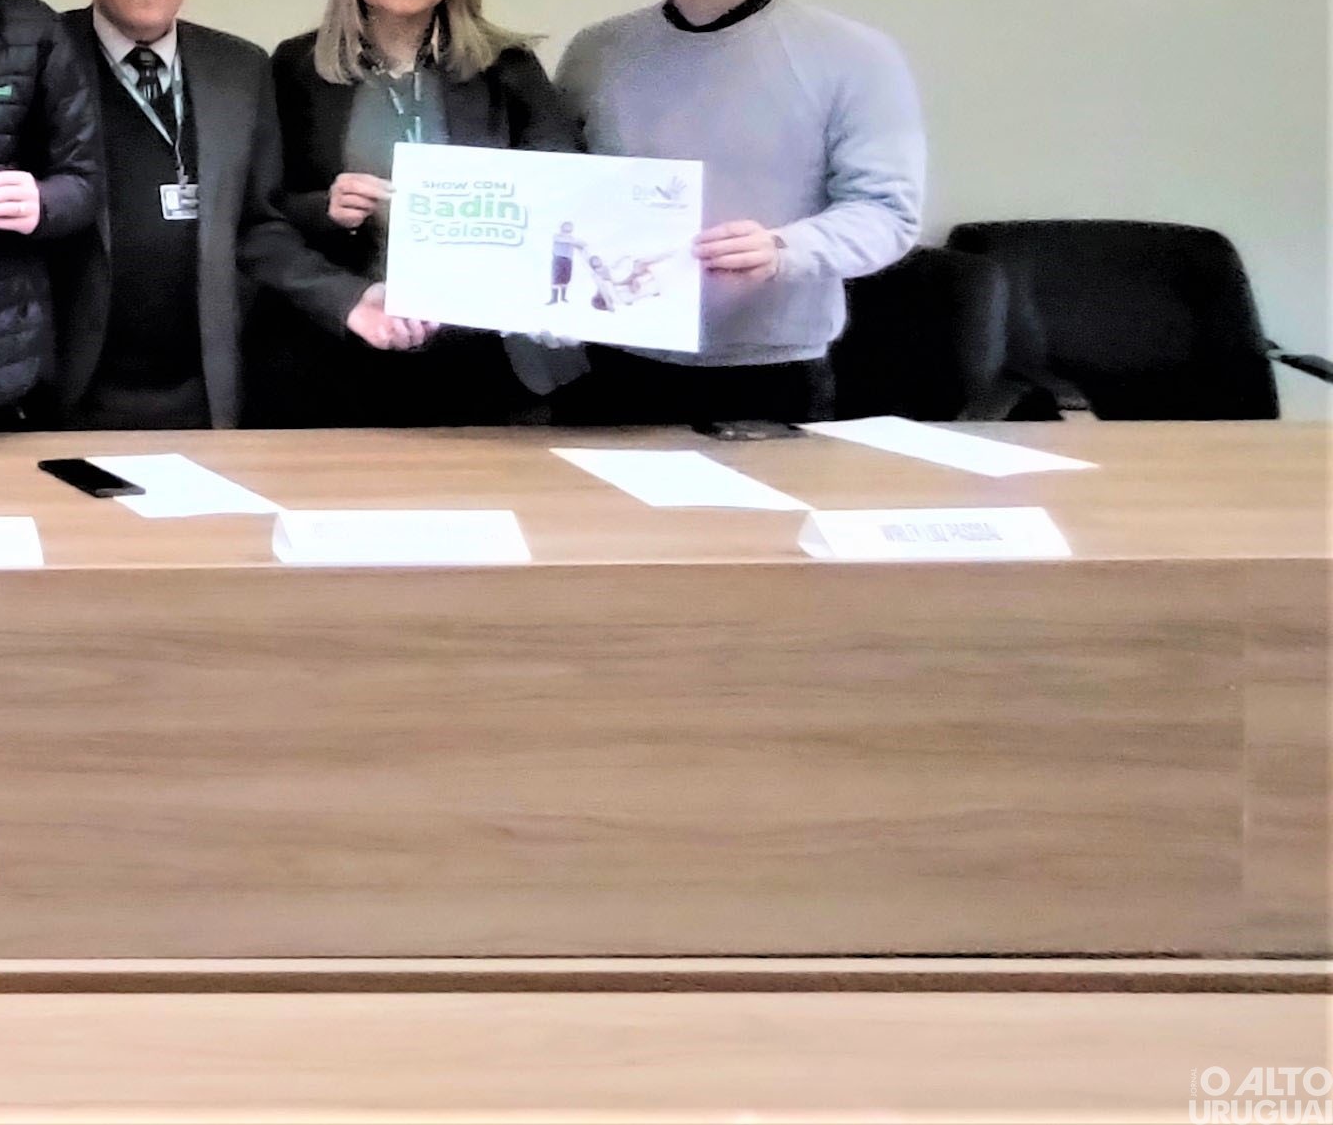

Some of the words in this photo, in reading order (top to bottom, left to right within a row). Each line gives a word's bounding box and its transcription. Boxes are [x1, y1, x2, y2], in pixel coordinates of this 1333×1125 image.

[421, 180, 468, 190] SHOW
[473, 180, 507, 190] COM
[409, 192, 521, 221] Badin
[432, 224, 517, 239] Colono
